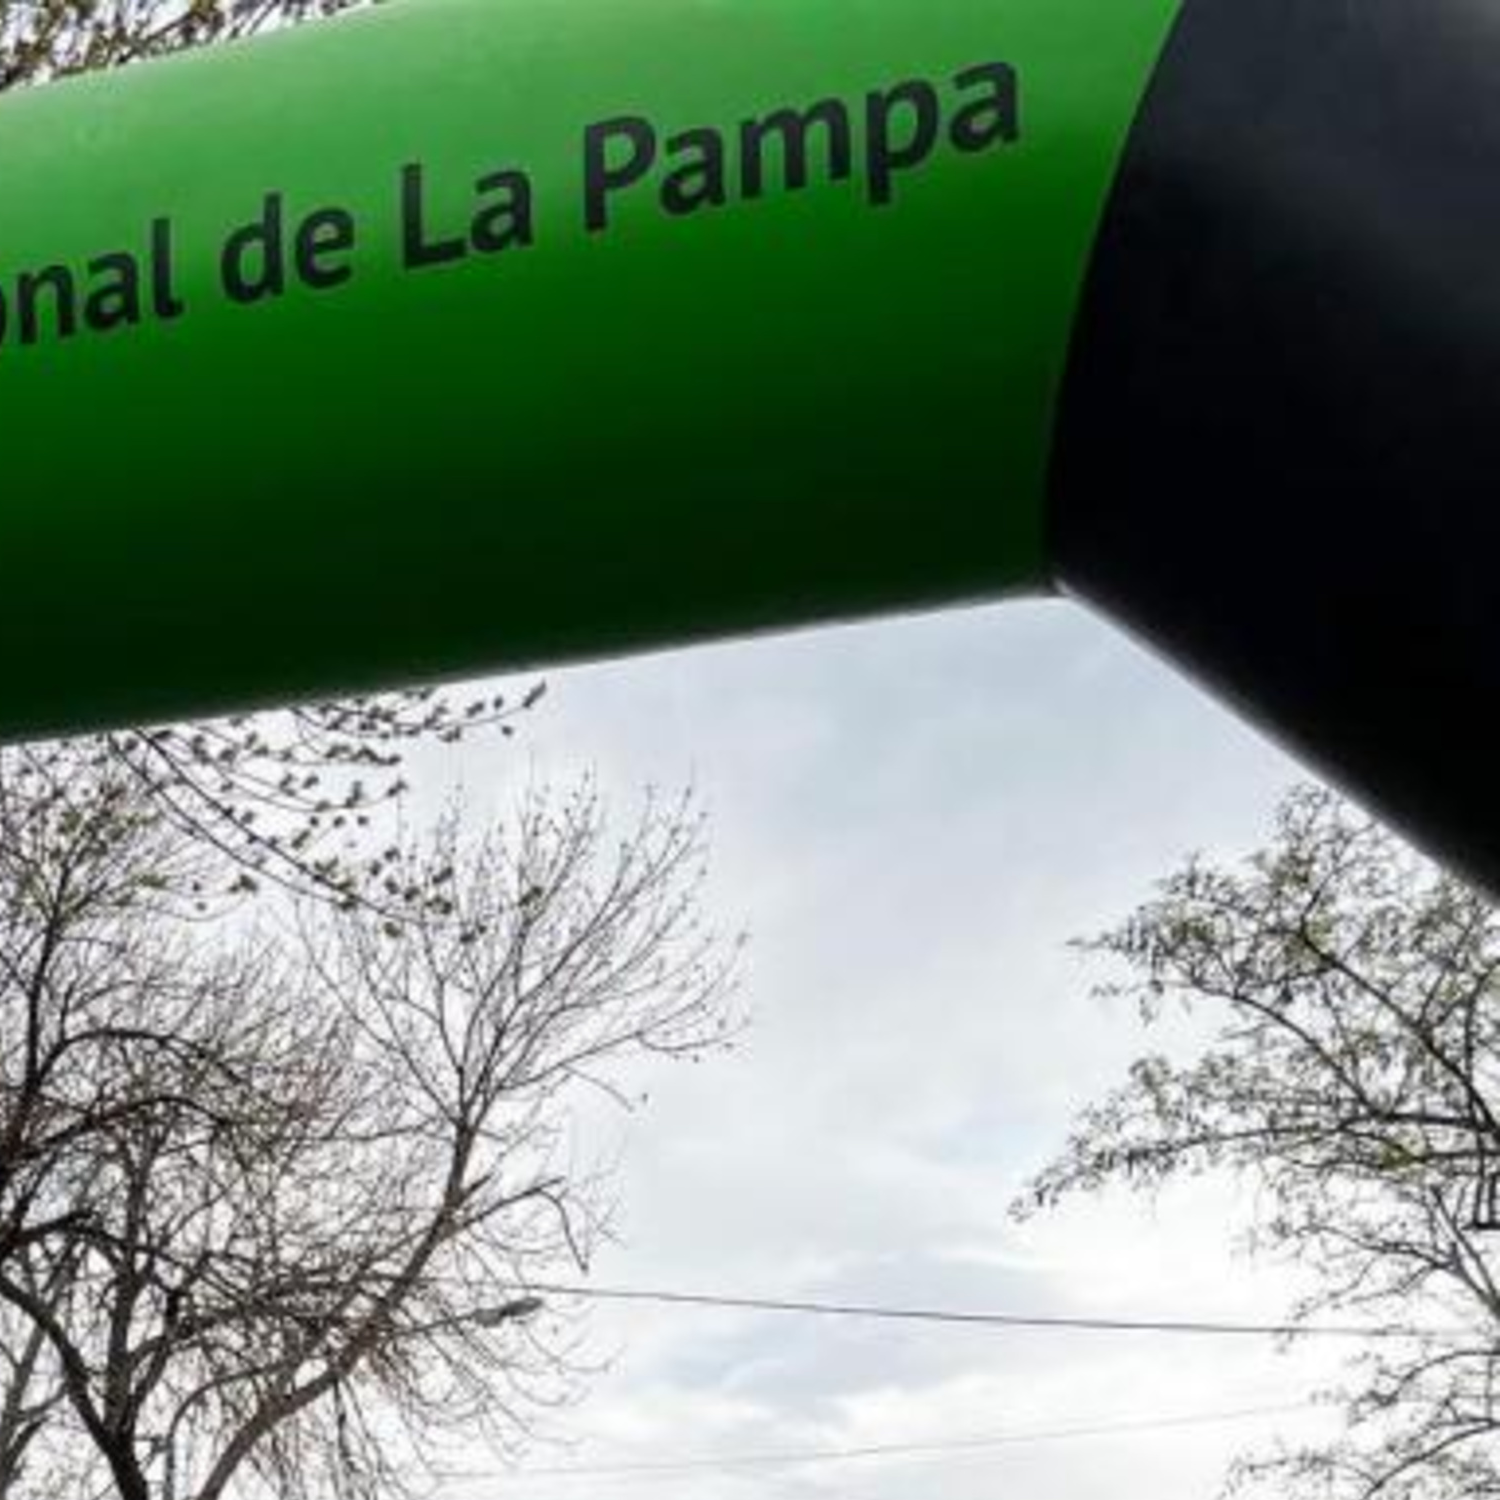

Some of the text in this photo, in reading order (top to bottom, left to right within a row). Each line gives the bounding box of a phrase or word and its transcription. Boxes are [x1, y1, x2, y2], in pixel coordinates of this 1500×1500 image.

[217, 193, 357, 310] de
[401, 162, 534, 272] La
[581, 60, 1022, 233] Pampa
